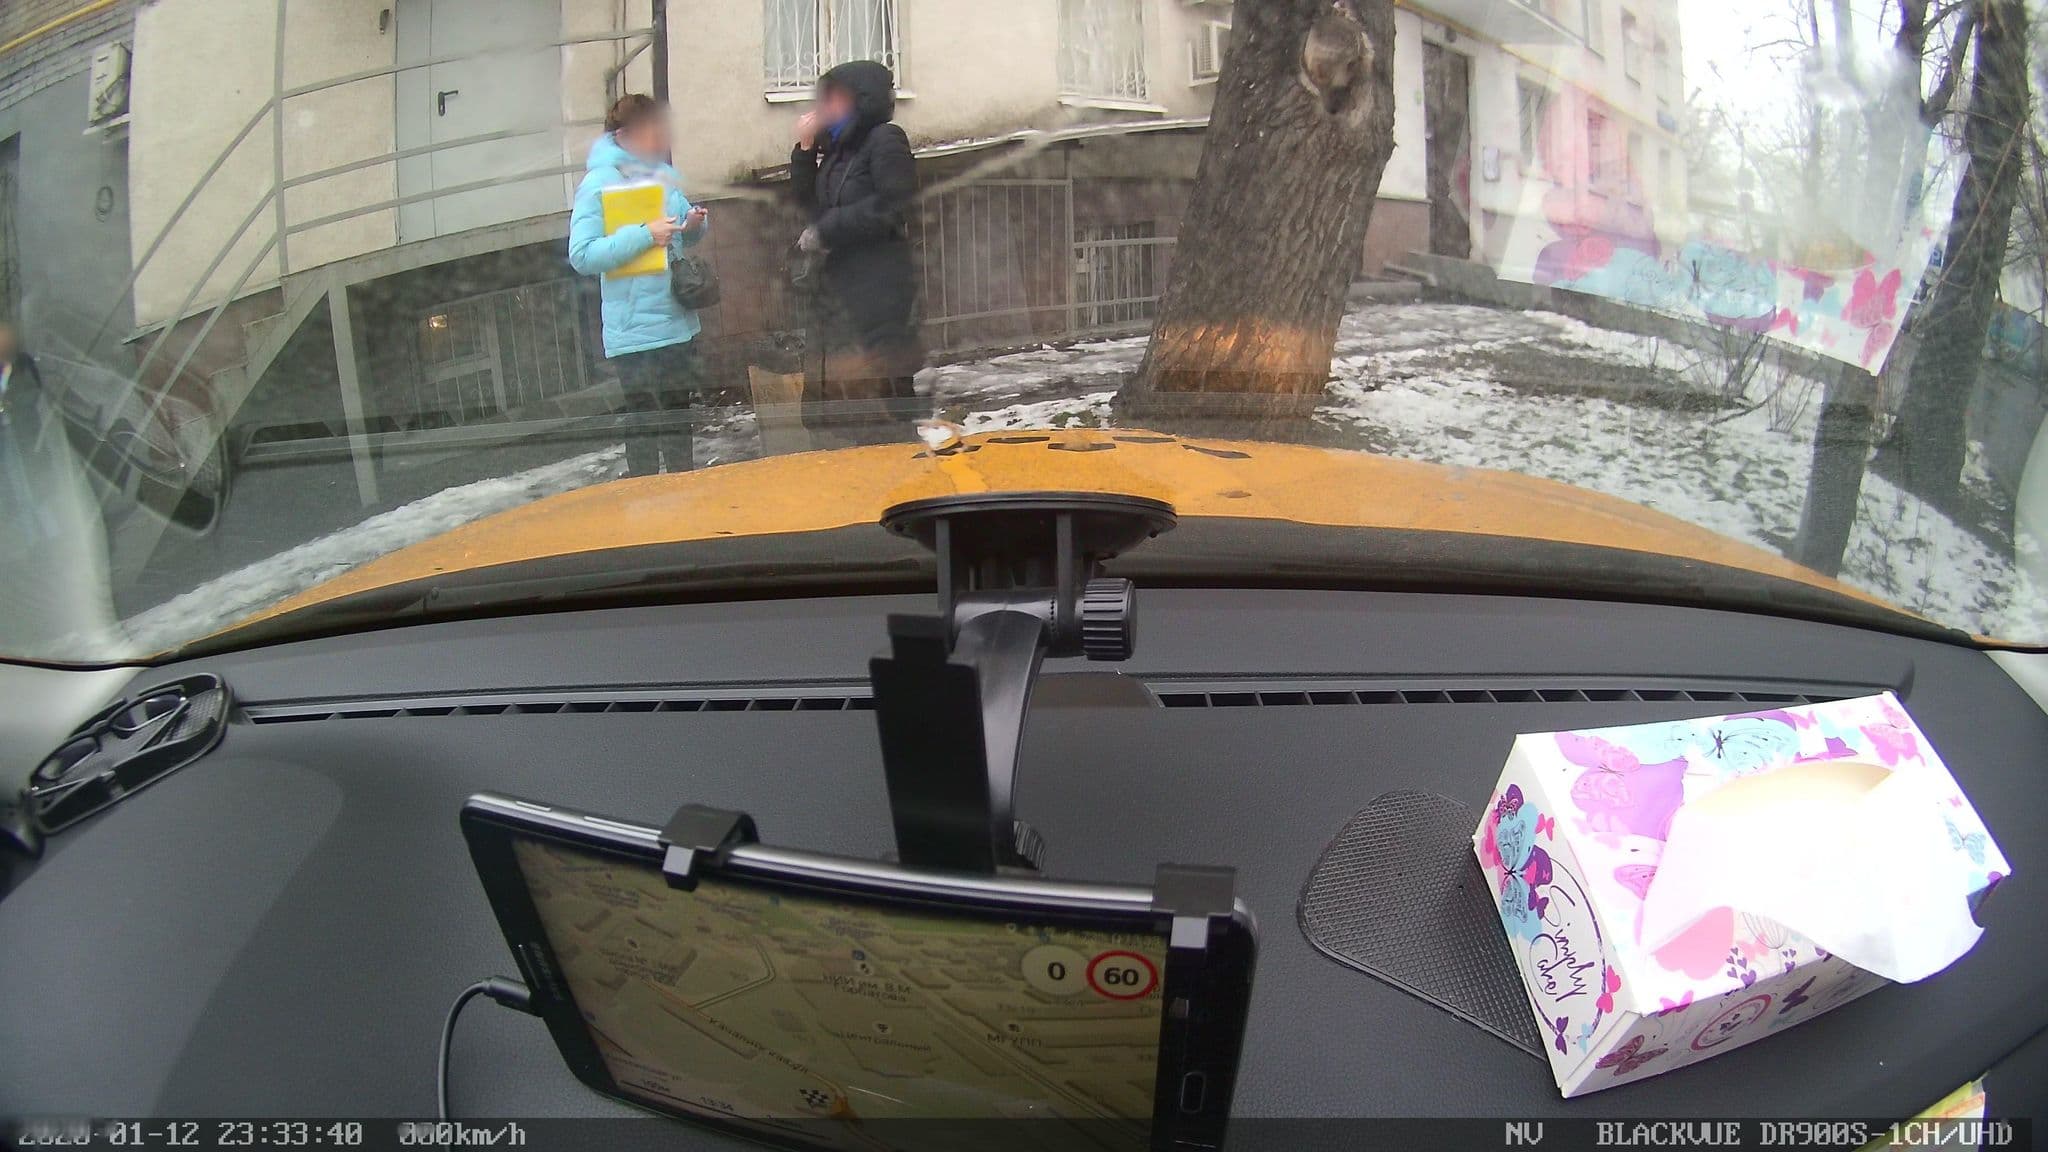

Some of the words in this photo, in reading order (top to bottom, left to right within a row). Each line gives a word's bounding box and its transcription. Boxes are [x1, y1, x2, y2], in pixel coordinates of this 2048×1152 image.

[1543, 885, 1595, 1003] Simply
[1047, 961, 1067, 981] 0
[1103, 966, 1139, 986] 60
